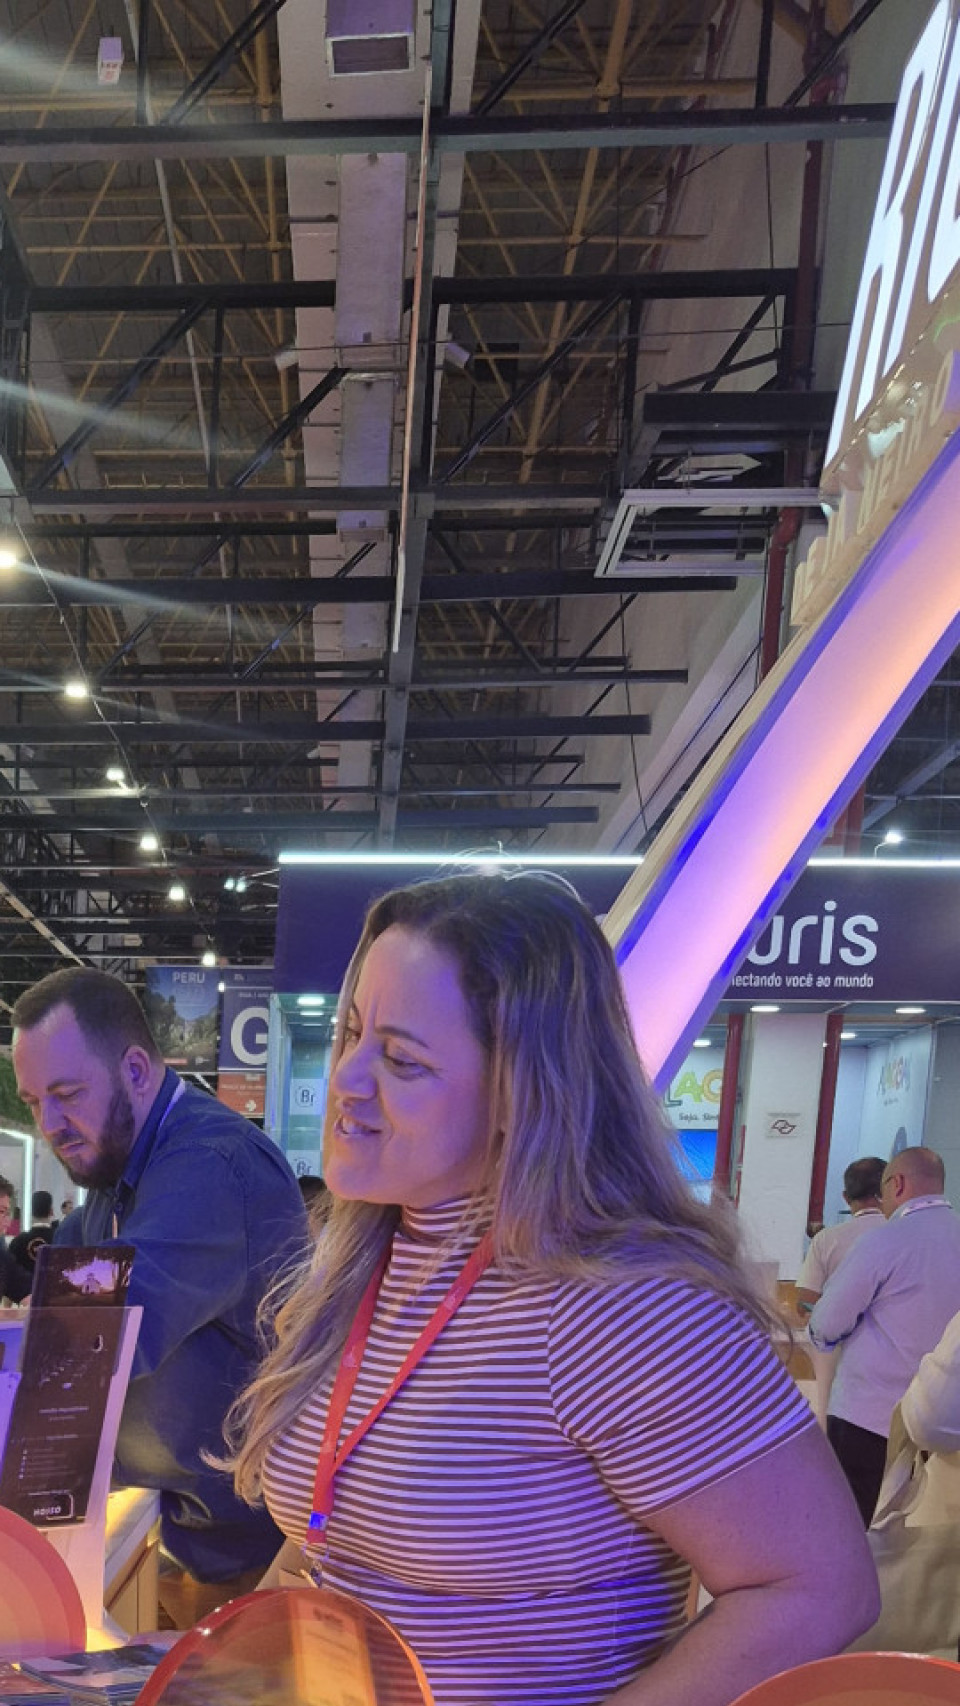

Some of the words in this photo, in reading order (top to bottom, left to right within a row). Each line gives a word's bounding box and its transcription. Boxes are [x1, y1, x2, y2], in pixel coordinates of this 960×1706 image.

[172, 971, 205, 984] PERU
[785, 972, 813, 988] você
[816, 975, 831, 988] ao
[834, 972, 874, 989] mundo
[230, 1006, 269, 1066] G
